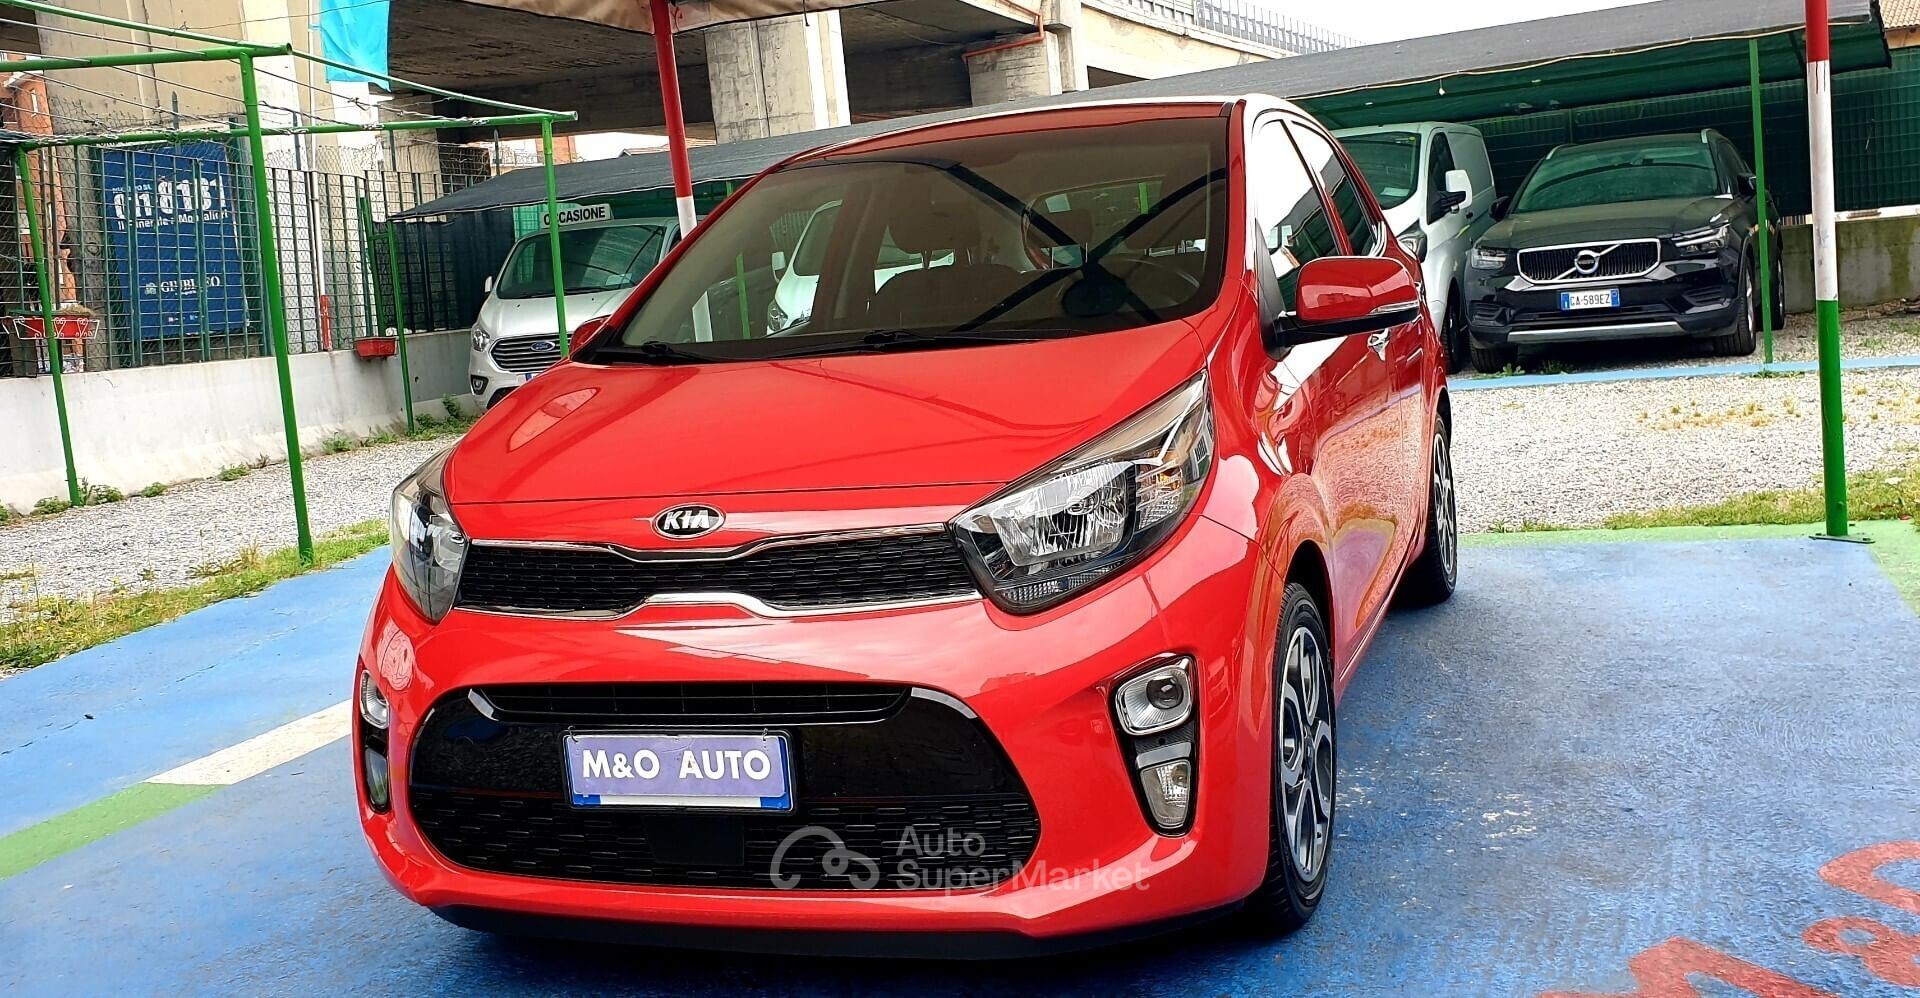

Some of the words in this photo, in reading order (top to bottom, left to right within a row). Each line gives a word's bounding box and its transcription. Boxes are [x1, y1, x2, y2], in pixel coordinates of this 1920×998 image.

[543, 206, 606, 226] OCASIONE
[160, 275, 220, 293] GIUBIEO
[663, 509, 711, 530] KIA
[582, 749, 661, 779] M&O
[679, 749, 772, 780] AUTO
